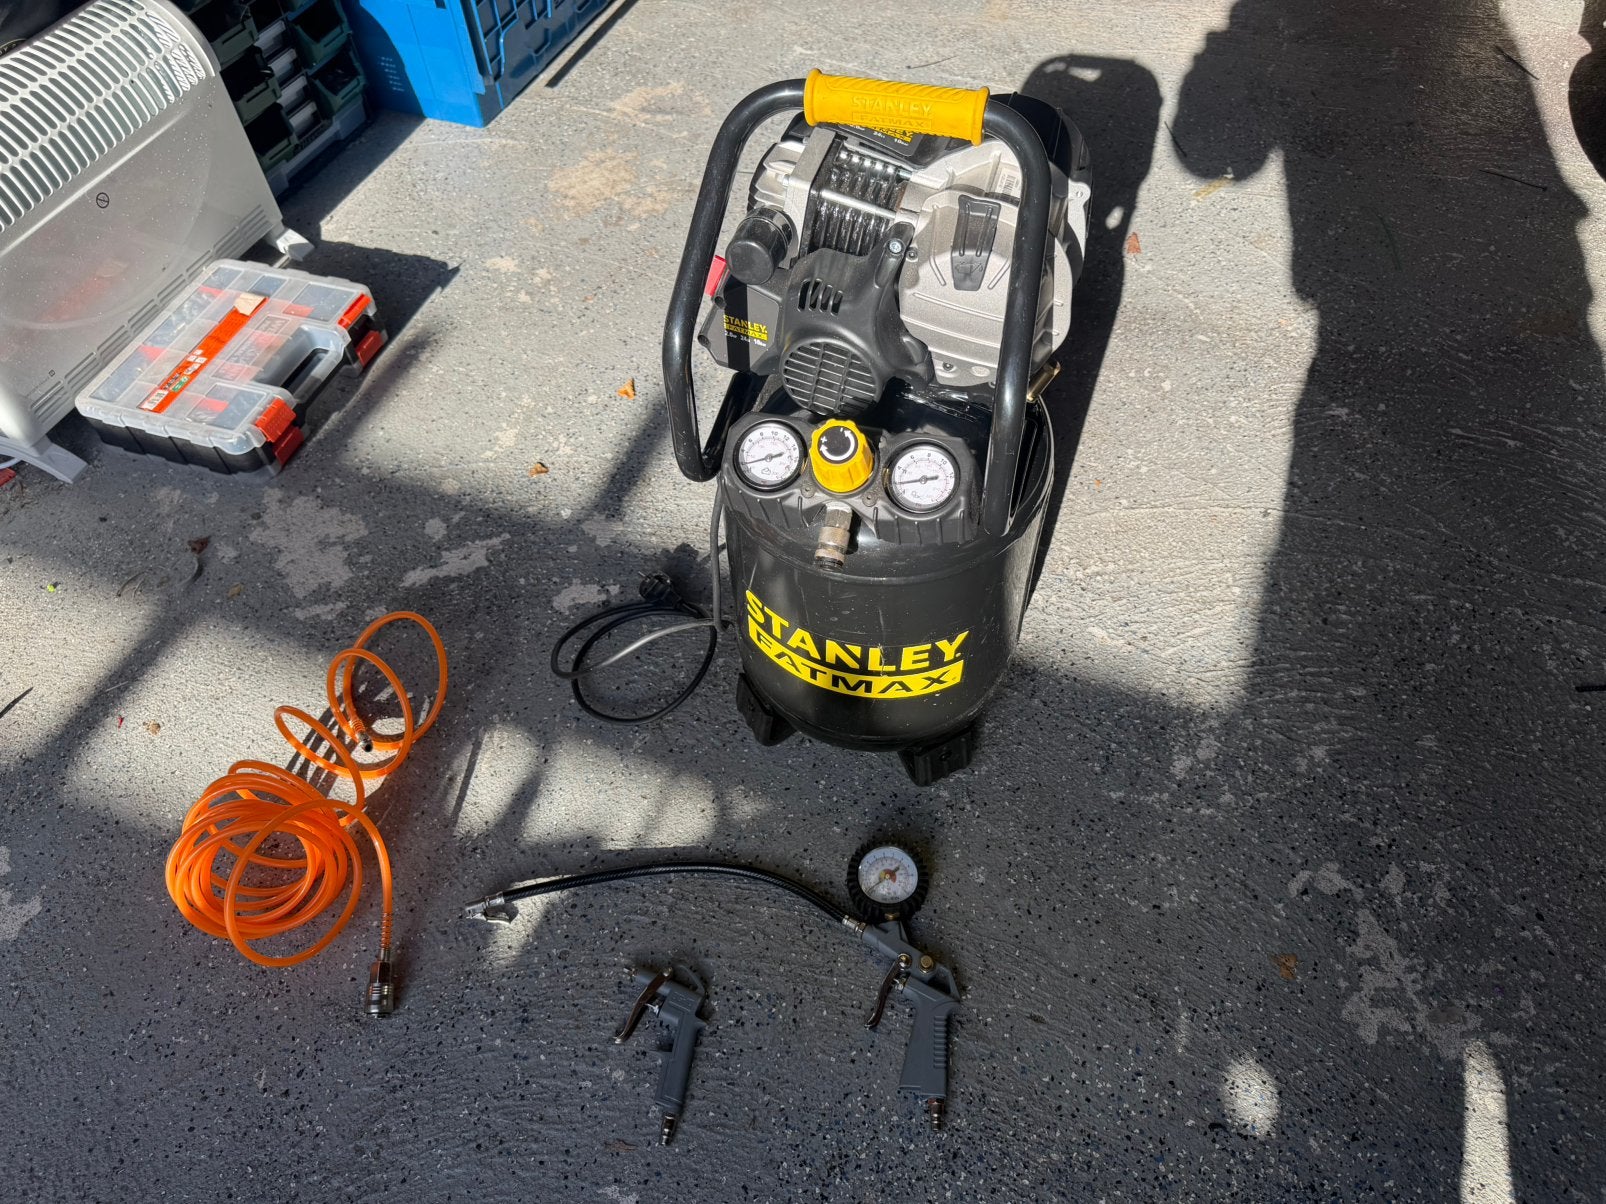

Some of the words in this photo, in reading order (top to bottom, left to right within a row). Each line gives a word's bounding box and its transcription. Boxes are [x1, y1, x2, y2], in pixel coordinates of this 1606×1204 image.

[851, 95, 933, 117] STANLEY
[860, 113, 925, 128] FATMAX
[723, 314, 768, 334] STANLEY
[745, 589, 970, 671] STANLEY
[755, 633, 952, 695] FATMAX
